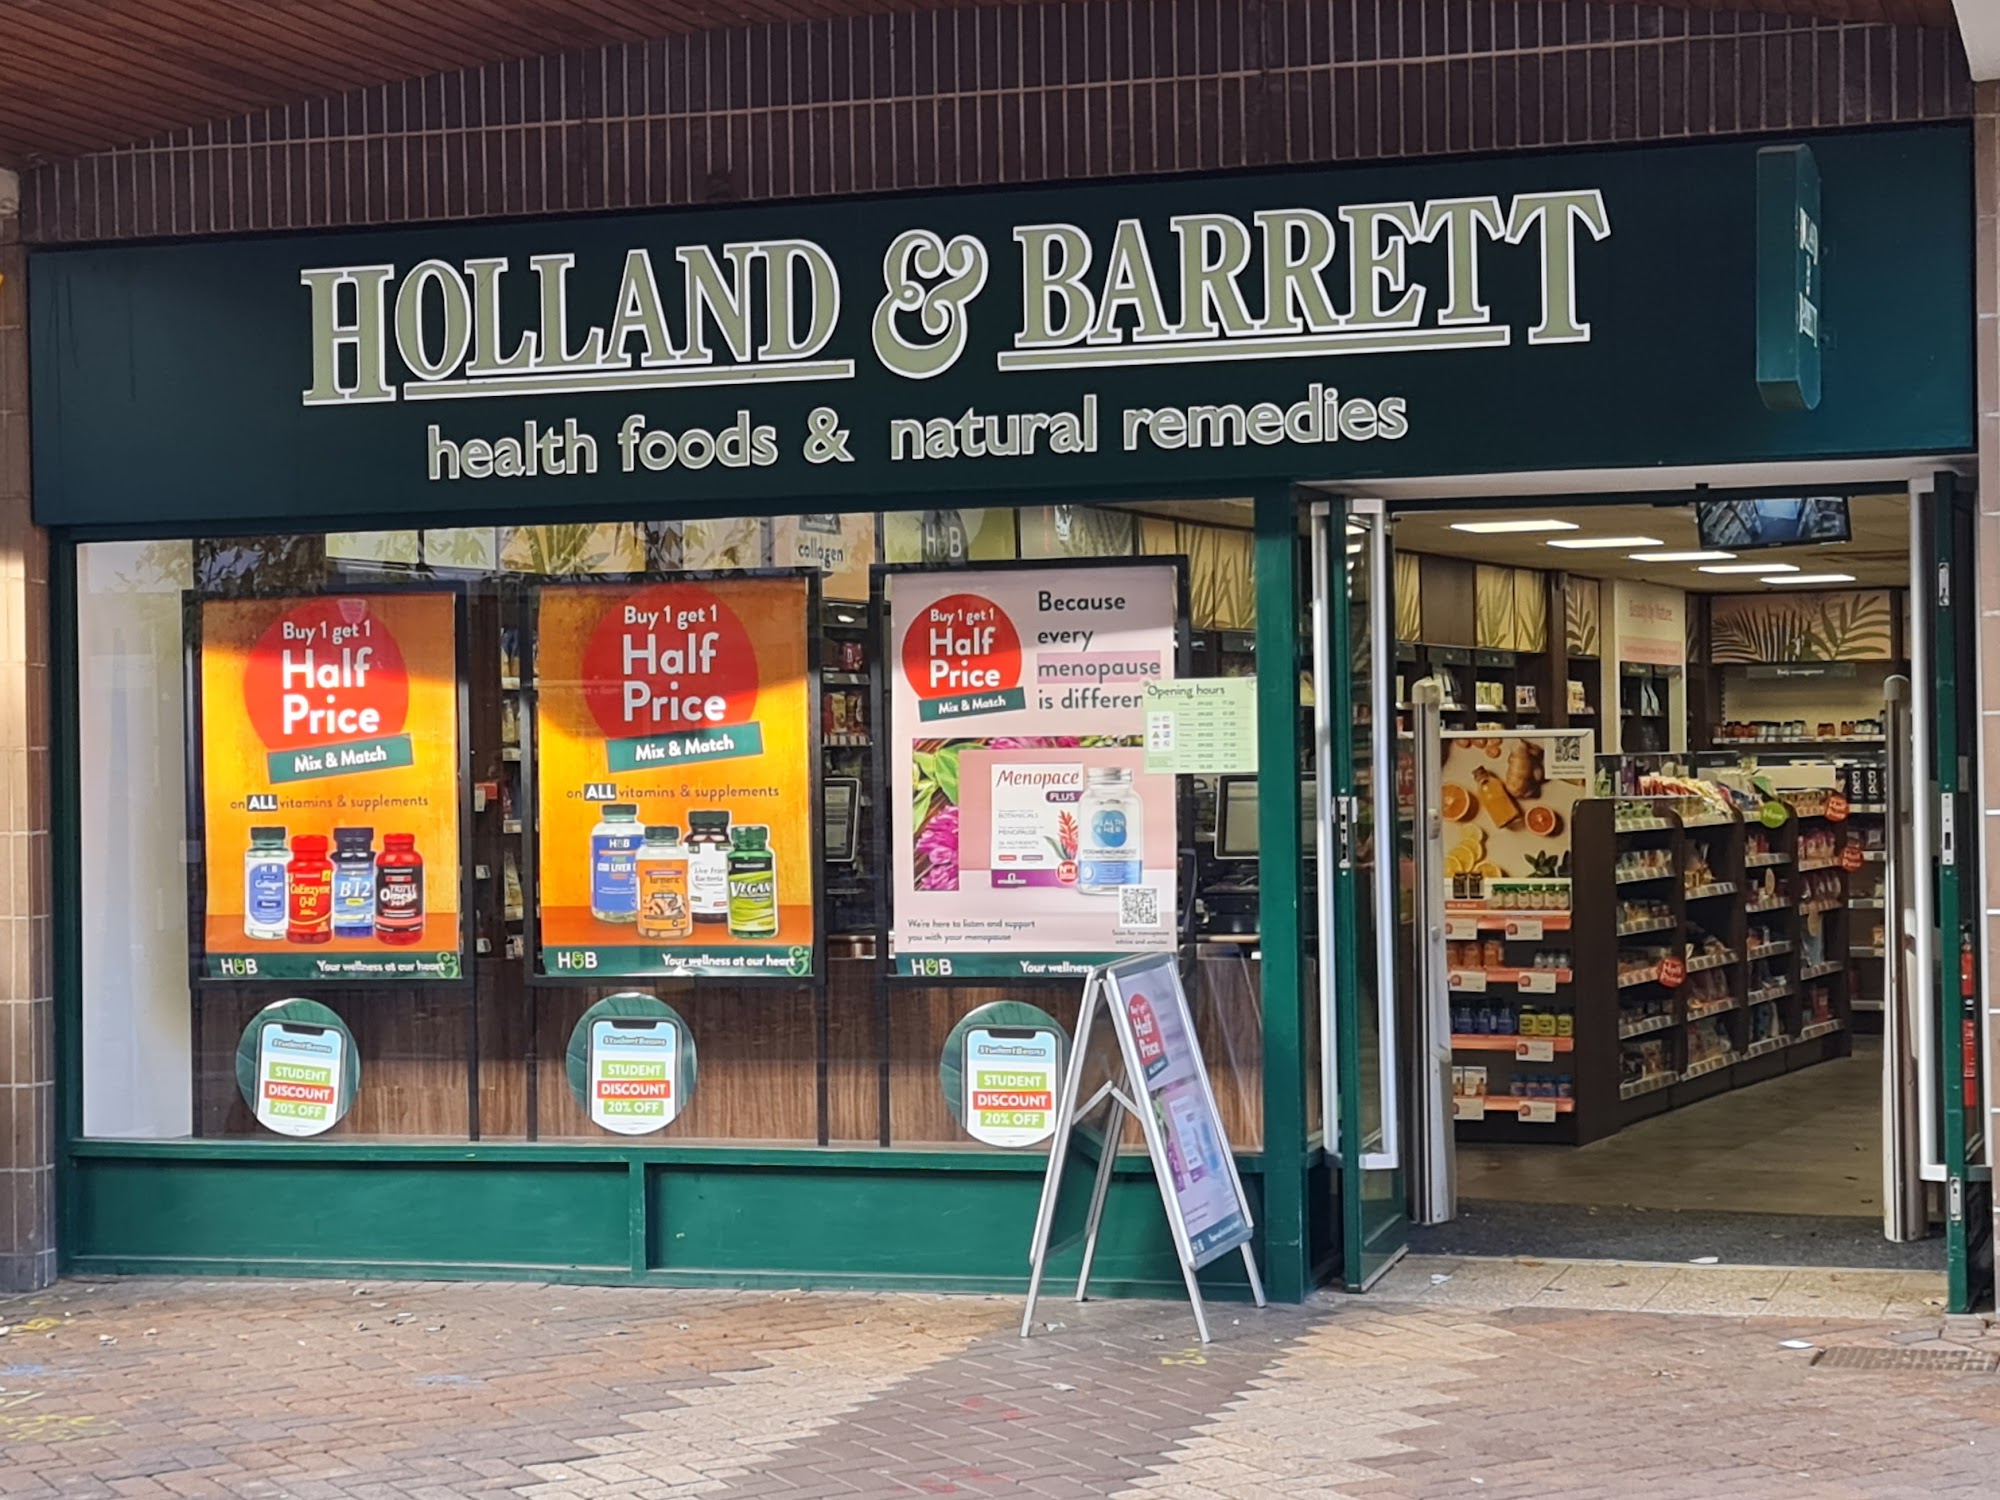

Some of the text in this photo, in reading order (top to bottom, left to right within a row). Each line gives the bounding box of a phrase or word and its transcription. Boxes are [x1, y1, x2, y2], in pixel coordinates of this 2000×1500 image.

[301, 239, 841, 405] HOLLAND
[872, 229, 988, 379] &
[1013, 189, 1611, 348] BARRETT
[428, 383, 1408, 480] health foods & natural remedies
[798, 538, 844, 569] collagen
[1038, 590, 1126, 612] Because
[624, 604, 718, 631] Buy 1 get 1
[930, 607, 994, 626] Buy 1 get 1
[282, 620, 371, 646] Buy 1 get 1
[929, 627, 996, 656] Half
[1037, 630, 1094, 652] every
[622, 632, 719, 675] Half
[282, 648, 373, 690] Half
[929, 659, 1001, 688] Price
[1037, 658, 1161, 682] menopause
[623, 680, 726, 721] Price
[1038, 687, 1143, 710] is differen
[1147, 683, 1225, 700] Opening hours
[938, 696, 1007, 714] Mix & Match
[283, 694, 380, 735] Price
[635, 733, 735, 762] Mix & Match
[294, 745, 387, 773] Mix & Match
[996, 770, 1080, 790] Menopace
[566, 784, 779, 802] on ALL vitamins & supplements
[1049, 792, 1076, 801] PLUS
[230, 795, 428, 812] on ALL vitamins & supplements
[339, 881, 370, 897] B12
[730, 881, 771, 897] VEGAN
[986, 920, 1003, 928] and
[317, 960, 341, 972] Your
[342, 960, 383, 972] wellness
[398, 962, 415, 972] our
[416, 960, 445, 972] heart
[662, 954, 796, 967] Your wellness at our heart
[1020, 960, 1095, 974] Your wellness
[275, 1066, 328, 1082] STUDENT
[607, 1064, 662, 1076] STUDENT
[601, 1083, 667, 1095] DISCOUNT
[983, 1074, 1041, 1087] STUDENT
[268, 1084, 331, 1100] DISCOUNT
[977, 1094, 1048, 1107] DISCOUNT
[273, 1102, 323, 1118] 20% OFF
[607, 1101, 659, 1113] 20% OFF
[984, 1113, 1040, 1126] 20% OFF
